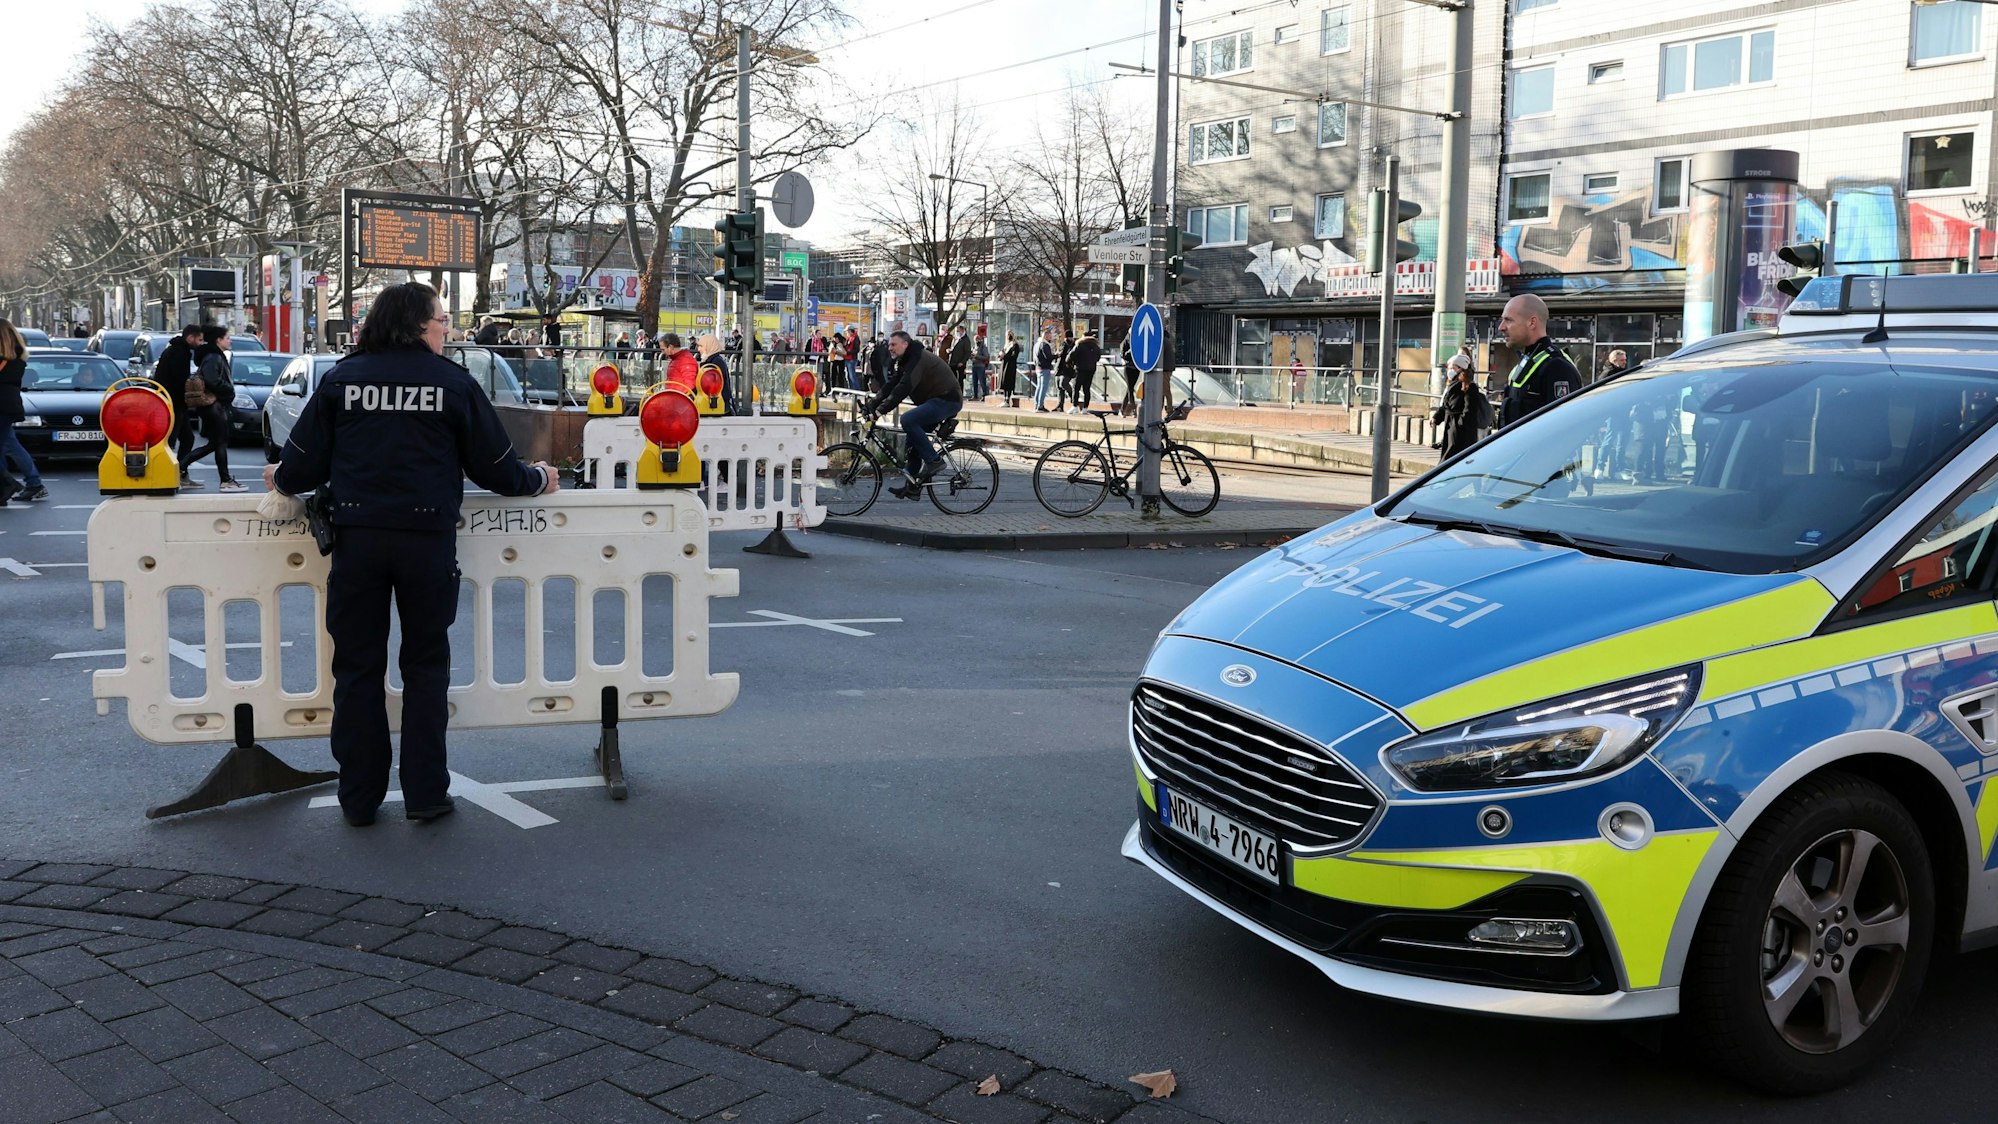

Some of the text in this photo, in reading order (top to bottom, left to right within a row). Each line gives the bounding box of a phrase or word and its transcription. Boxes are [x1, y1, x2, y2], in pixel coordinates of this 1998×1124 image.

[1104, 230, 1146, 246] Ehrenfeldgürtel
[1094, 249, 1145, 262] Venloer Str.
[1747, 251, 1790, 266] BLA
[898, 300, 904, 309] 3
[696, 316, 712, 324] MFO
[344, 386, 444, 412] POLIZEI
[1269, 563, 1504, 629] POLIZEI
[1168, 792, 1280, 877] NRW 4-7966
